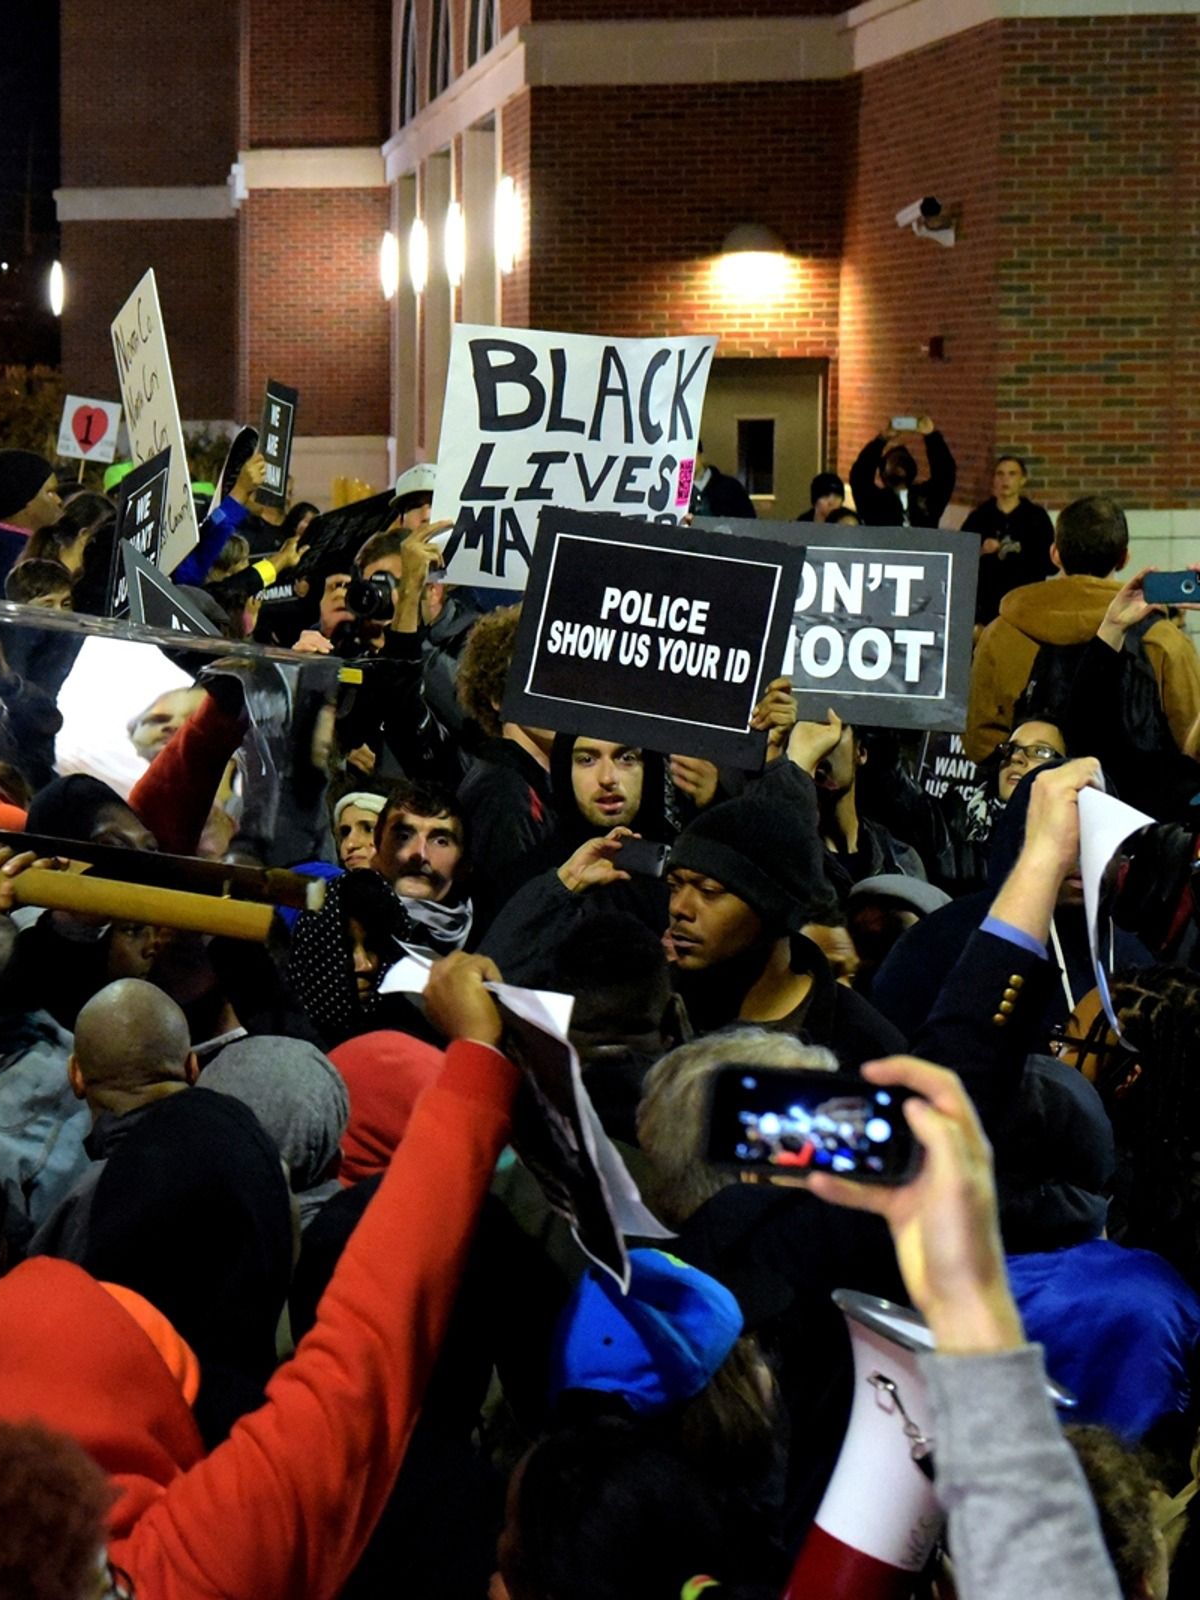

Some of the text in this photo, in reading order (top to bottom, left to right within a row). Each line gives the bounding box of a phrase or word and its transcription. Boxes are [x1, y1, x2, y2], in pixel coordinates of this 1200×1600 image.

[469, 339, 711, 445] BLACK
[460, 443, 677, 511] LIVES
[600, 587, 710, 635] POLICE
[547, 620, 751, 683] SHOW US YOUR ID
[935, 756, 978, 781] WANT
